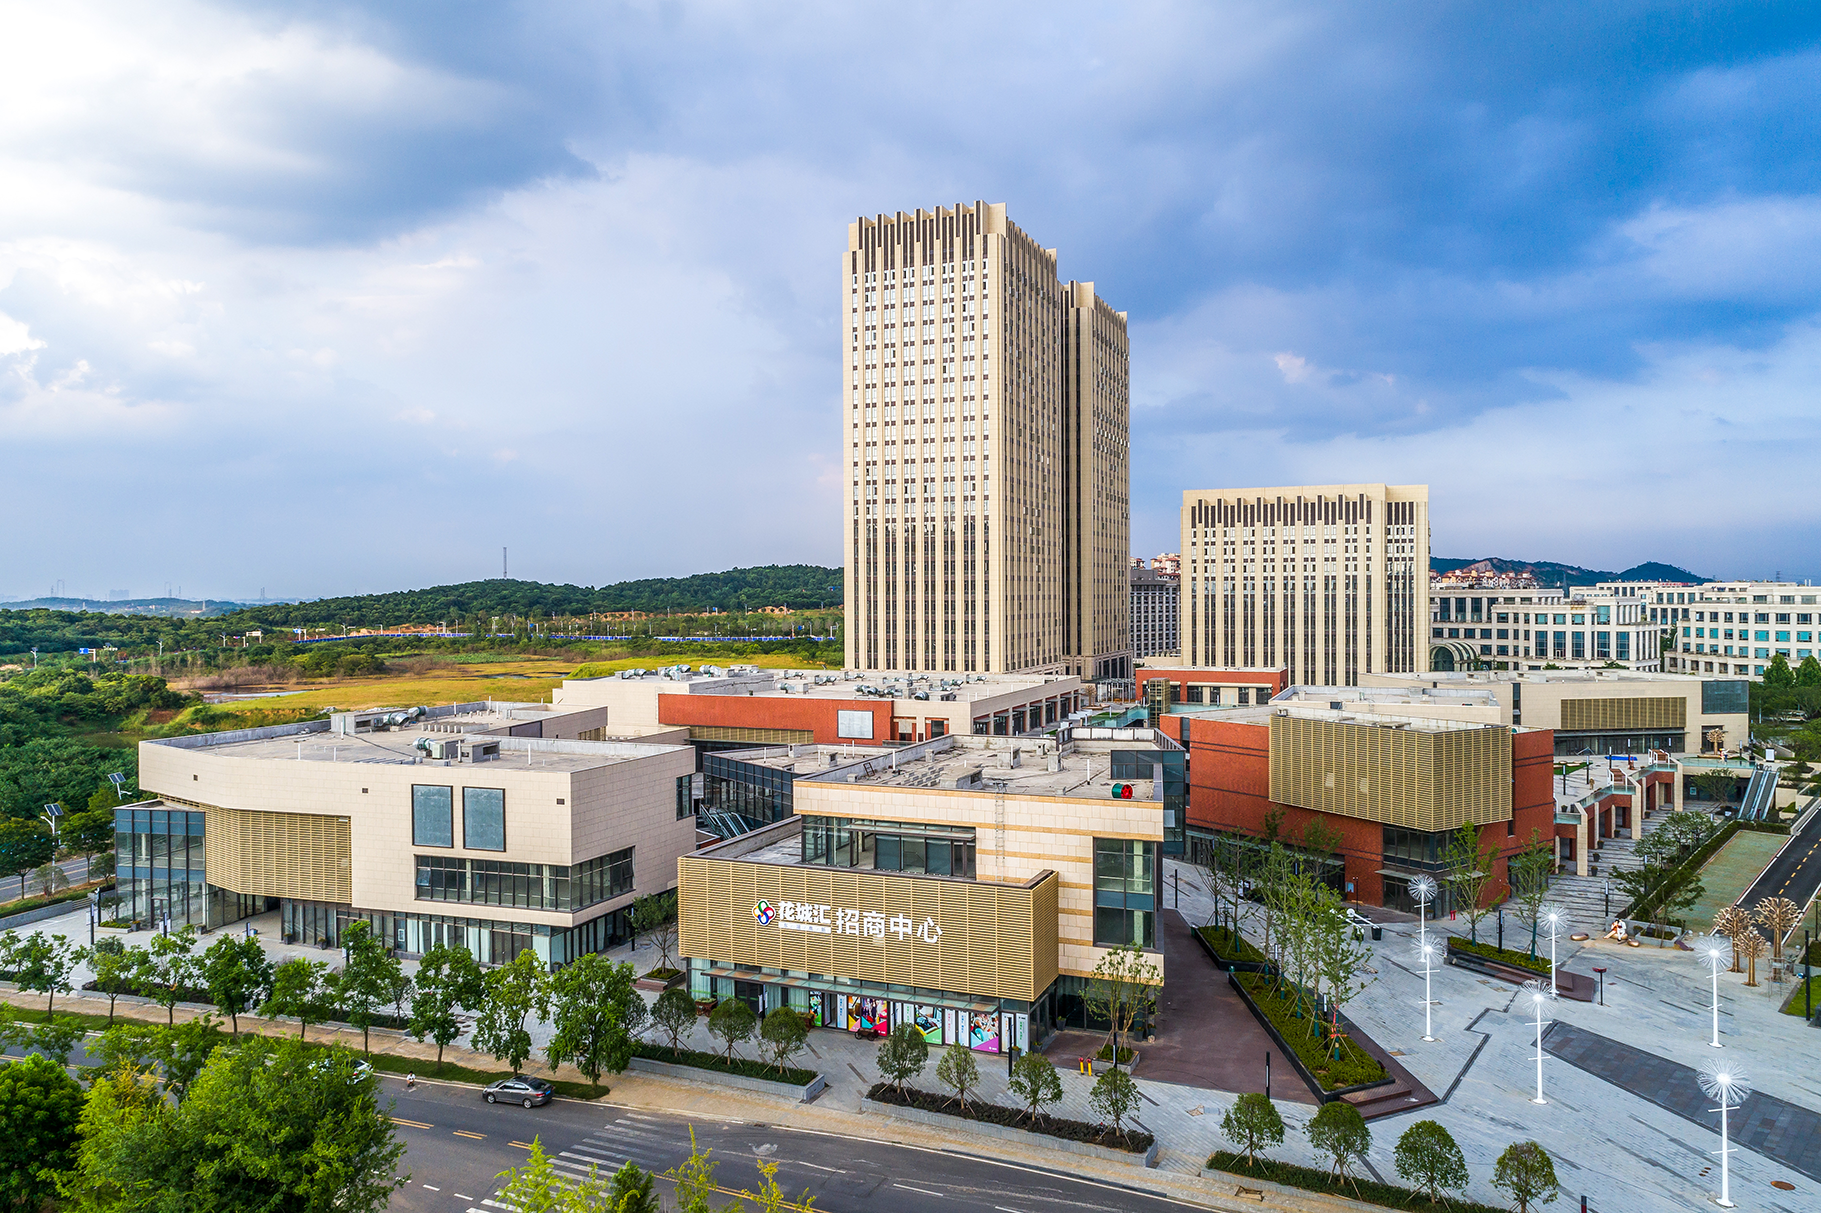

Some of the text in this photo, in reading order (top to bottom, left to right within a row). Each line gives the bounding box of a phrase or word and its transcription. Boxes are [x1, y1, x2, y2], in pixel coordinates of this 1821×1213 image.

[778, 901, 832, 924] 花城汇
[836, 907, 943, 944] 招商中心
